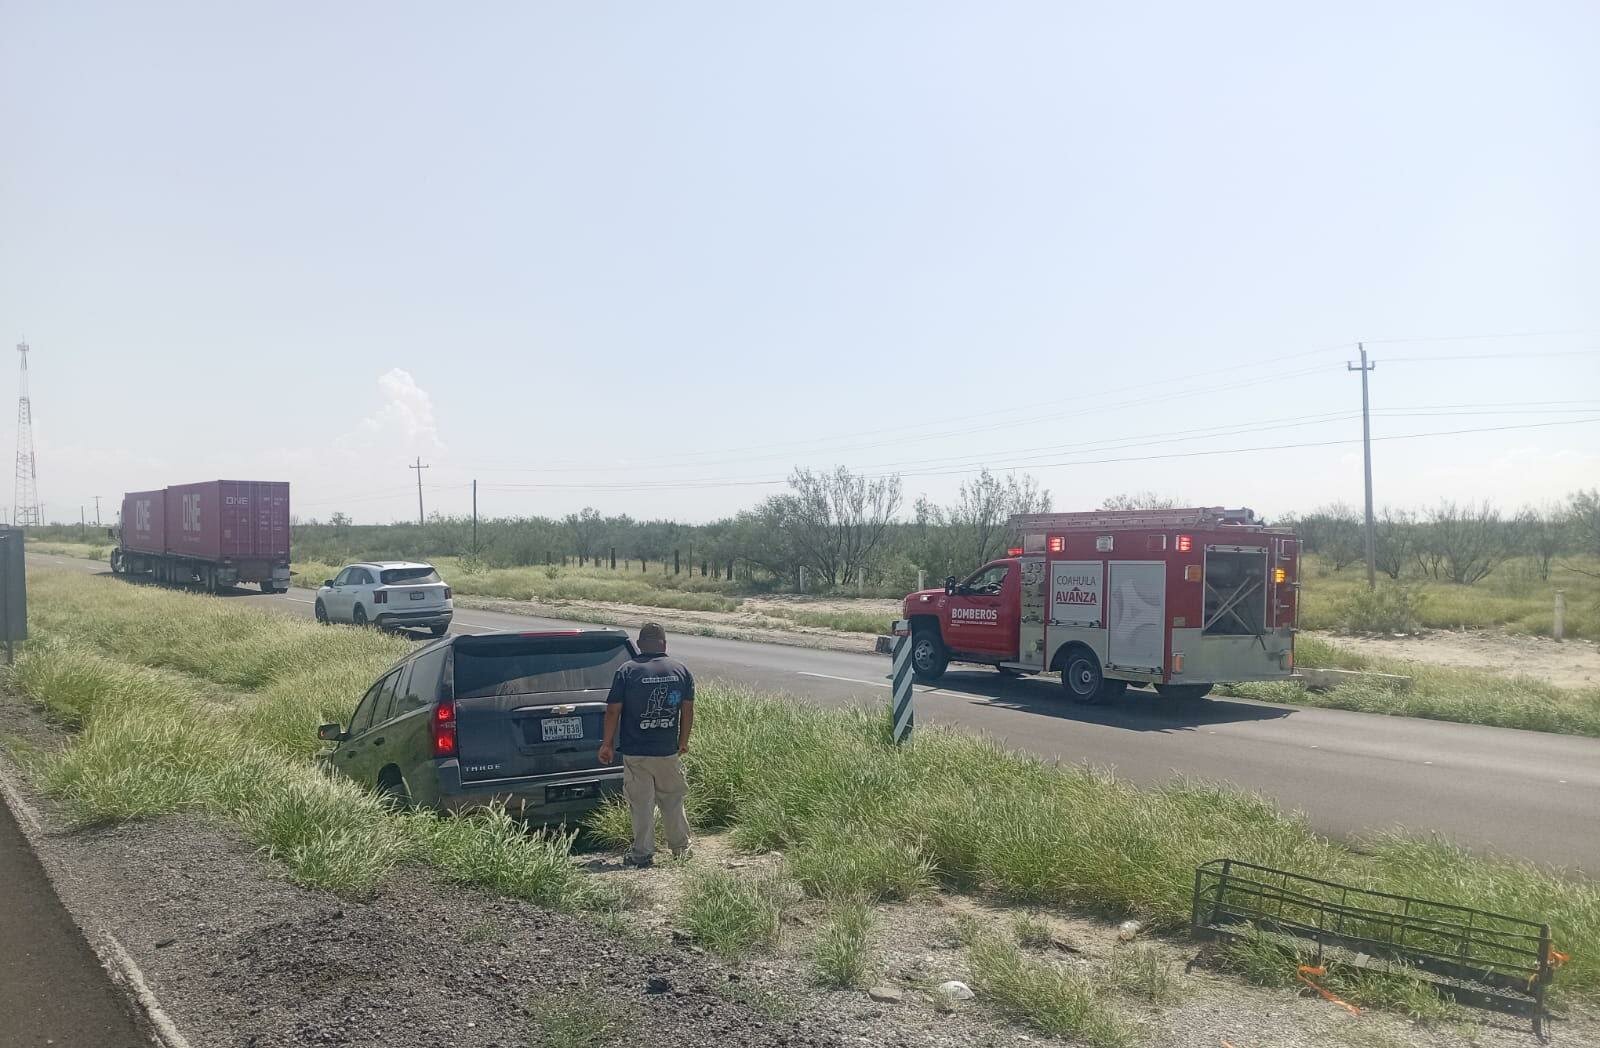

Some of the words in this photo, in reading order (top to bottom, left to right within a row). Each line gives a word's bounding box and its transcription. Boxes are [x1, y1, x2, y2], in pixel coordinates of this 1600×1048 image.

[226, 496, 249, 505] ONE
[1056, 575, 1097, 586] COAHUILA
[1055, 591, 1097, 604] AVANZA
[951, 608, 998, 620] BOMBEROS
[464, 763, 503, 773] TAHOE
